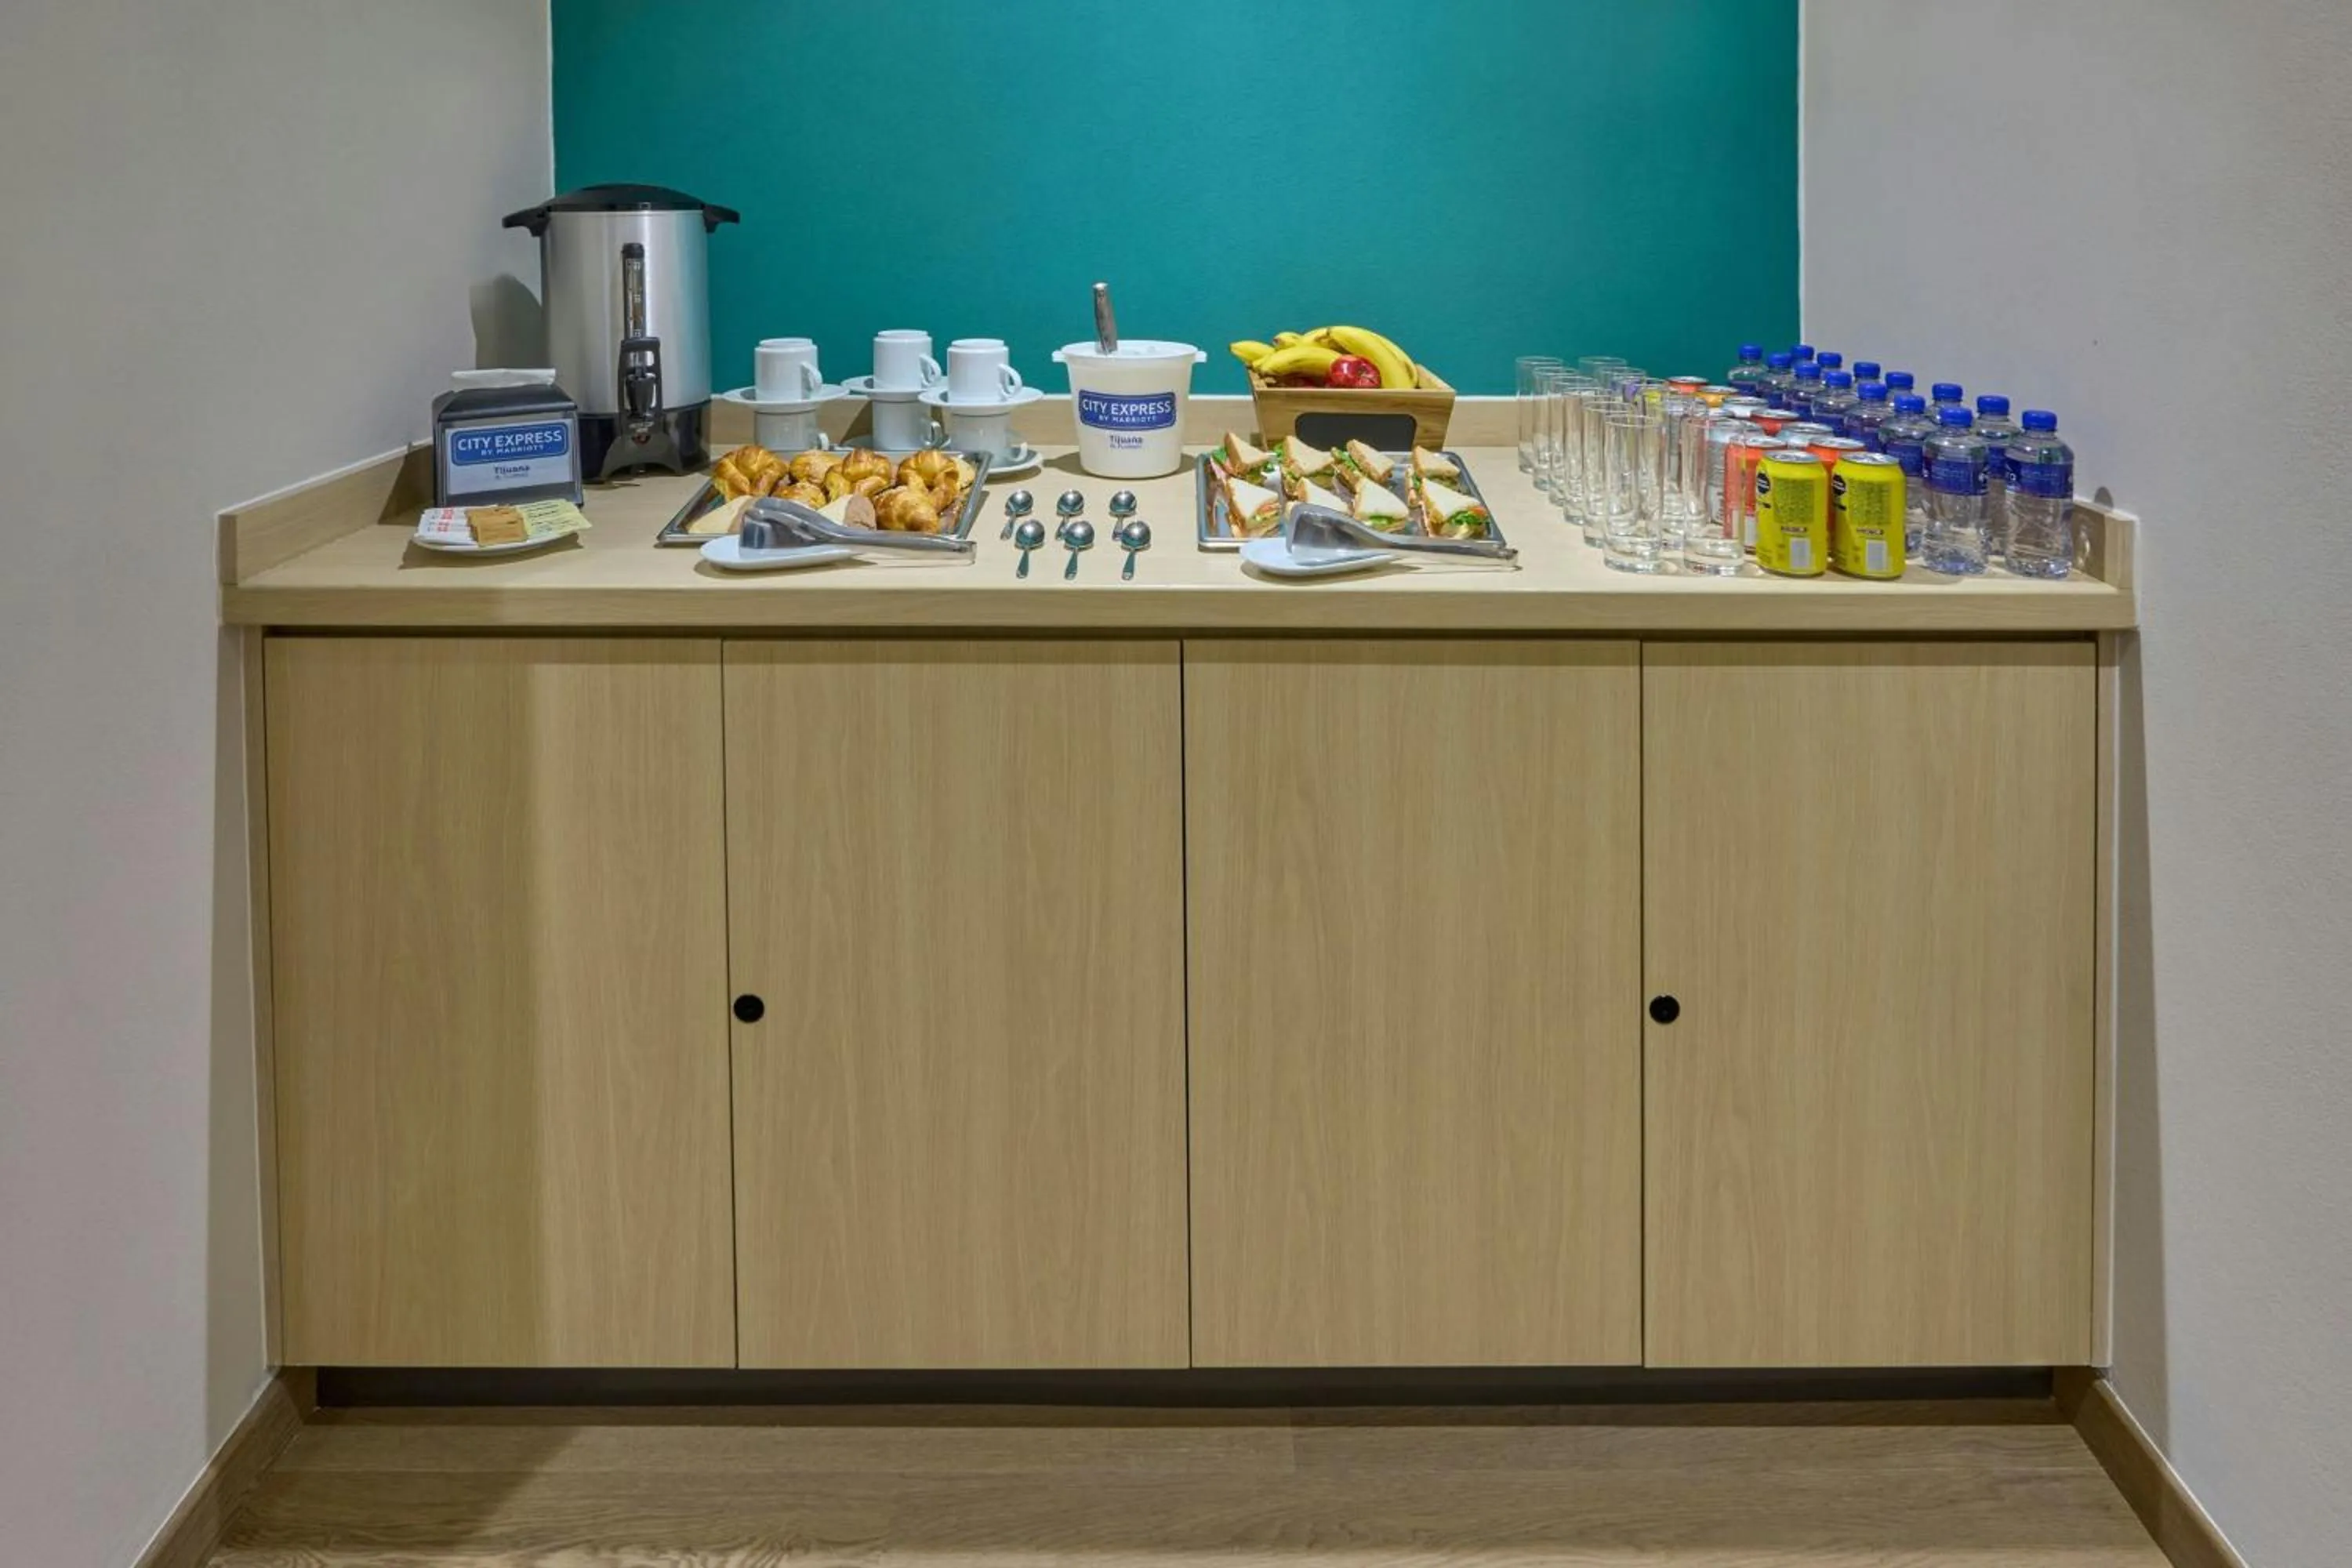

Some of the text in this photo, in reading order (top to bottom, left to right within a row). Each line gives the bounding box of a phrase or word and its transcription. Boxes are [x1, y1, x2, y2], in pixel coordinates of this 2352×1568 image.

[1083, 400, 1171, 416] CITY EXPRESS
[458, 430, 562, 451] CITY EXPRESS
[496, 445, 544, 455] MARRIOTT
[494, 466, 530, 474] Tijuana
